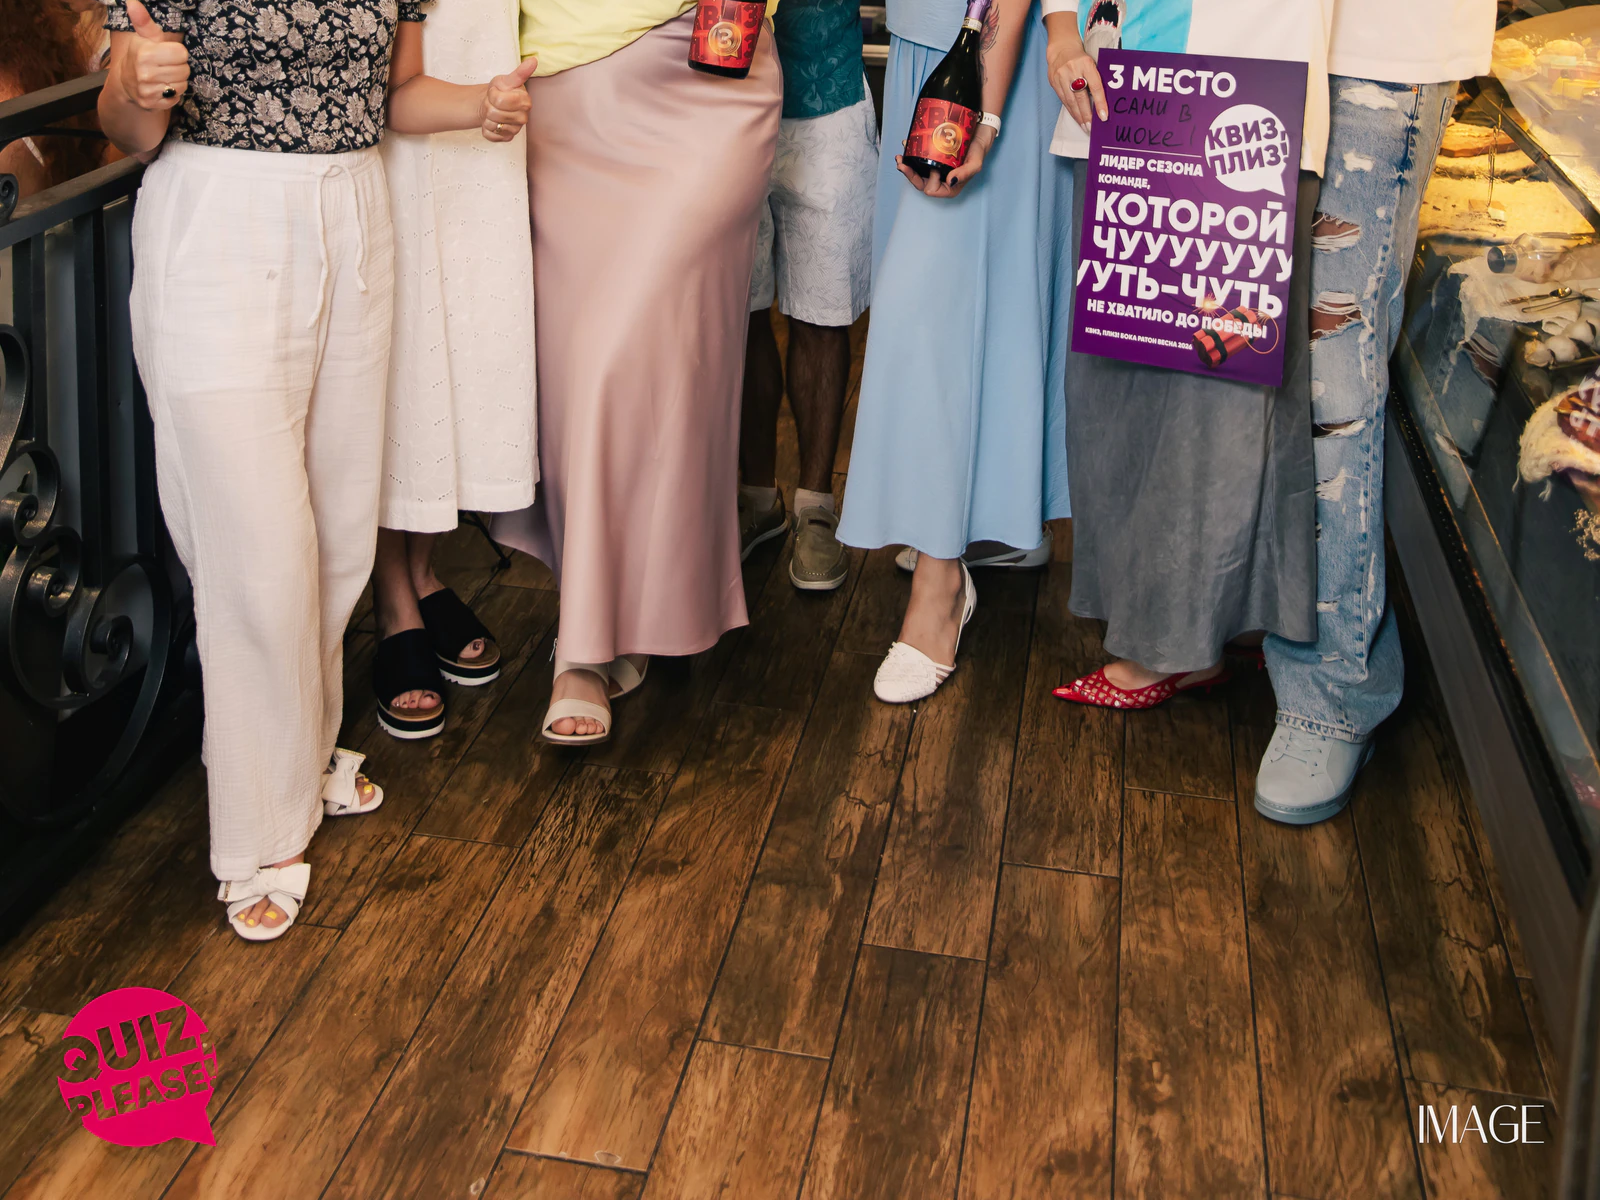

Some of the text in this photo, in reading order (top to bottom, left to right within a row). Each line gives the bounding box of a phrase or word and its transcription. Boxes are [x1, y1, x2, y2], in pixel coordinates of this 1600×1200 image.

[1107, 64, 1237, 98] 3 МЕСТО
[1207, 117, 1288, 150] КВИЗ,
[1099, 153, 1204, 177] ЛИДЕР СЕЗОНА
[1207, 142, 1289, 177] ПЛИЗ!
[1098, 173, 1151, 190] КОМАНДЕ,
[1094, 190, 1289, 245] КОТОРОЙ
[1086, 298, 1268, 339] НЕ ХВАТИЛО ДО ПОБЕДЫ
[1085, 326, 1102, 336] КВИЗ,
[1120, 332, 1137, 341] БОКА
[1137, 335, 1157, 345] РАТОН
[1157, 338, 1178, 348] ВЕСНА
[1178, 341, 1193, 350] 2026
